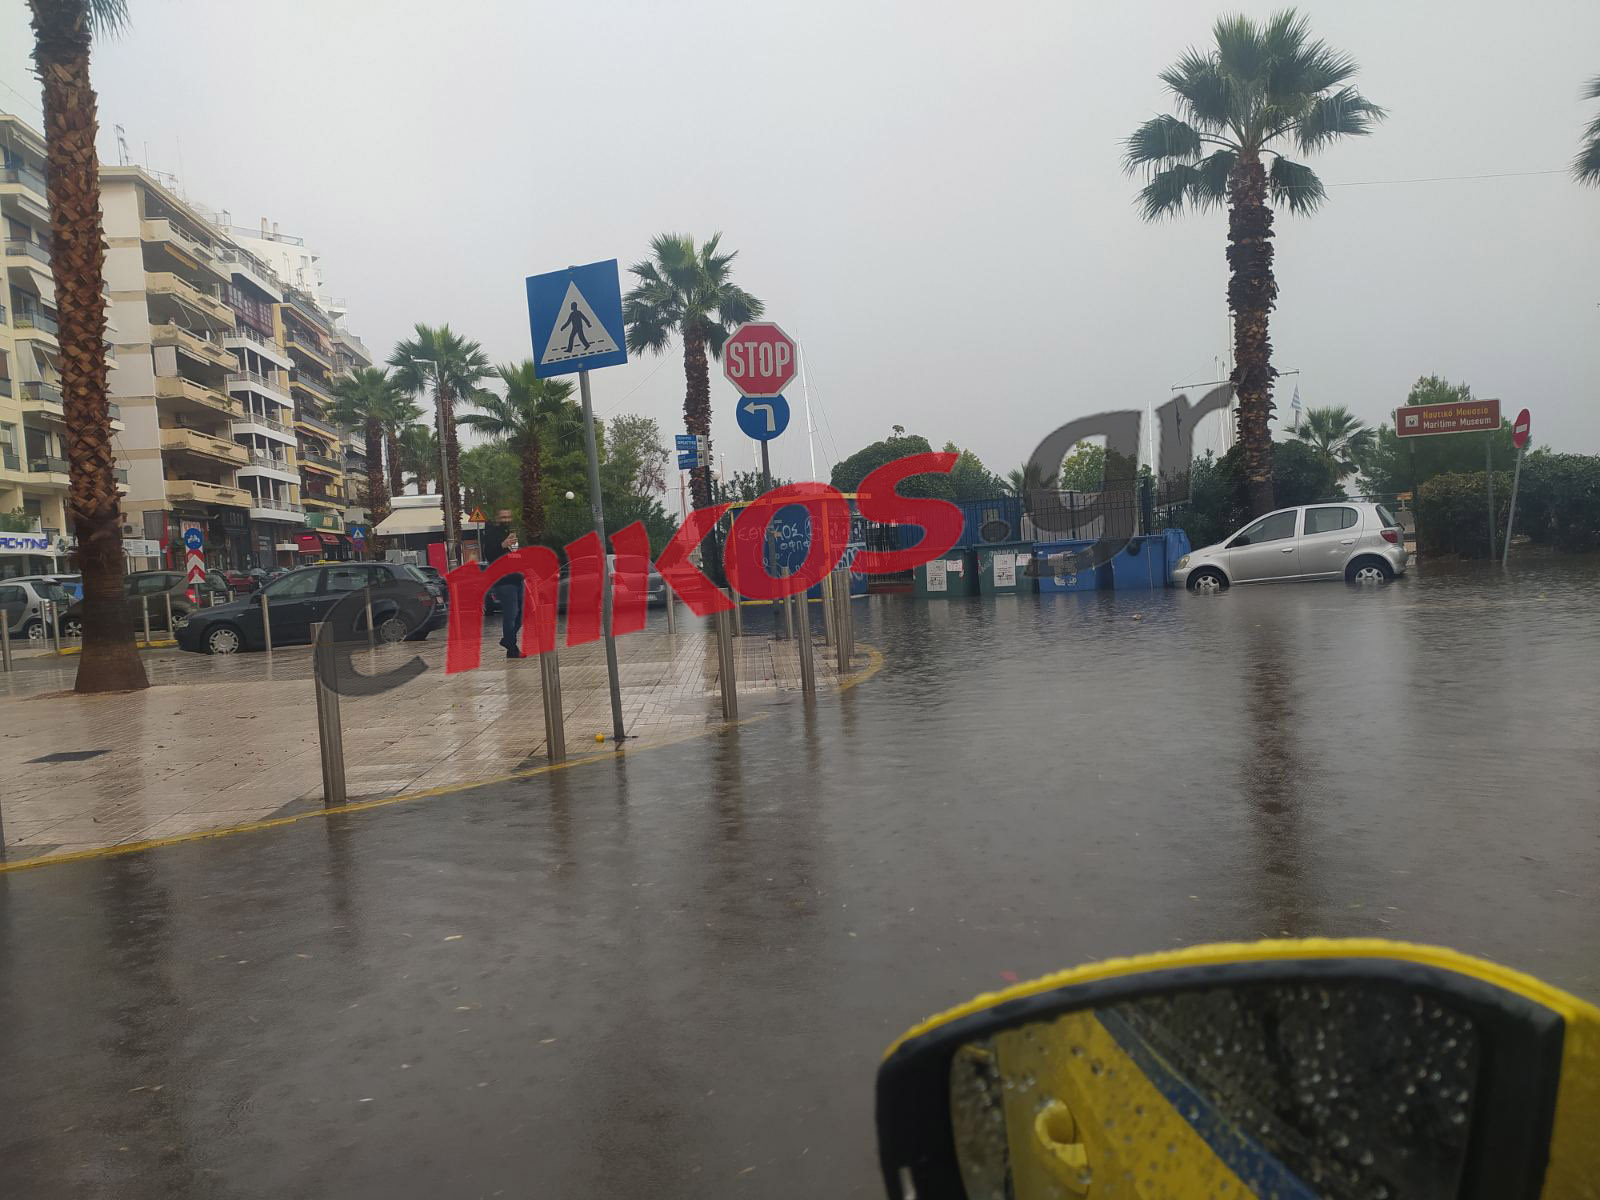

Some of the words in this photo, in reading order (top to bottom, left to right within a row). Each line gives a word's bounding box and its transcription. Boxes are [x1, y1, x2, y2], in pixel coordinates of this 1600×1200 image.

[729, 341, 790, 377] STOP
[1423, 419, 1456, 429] Maritime
[1460, 416, 1491, 427] Museum
